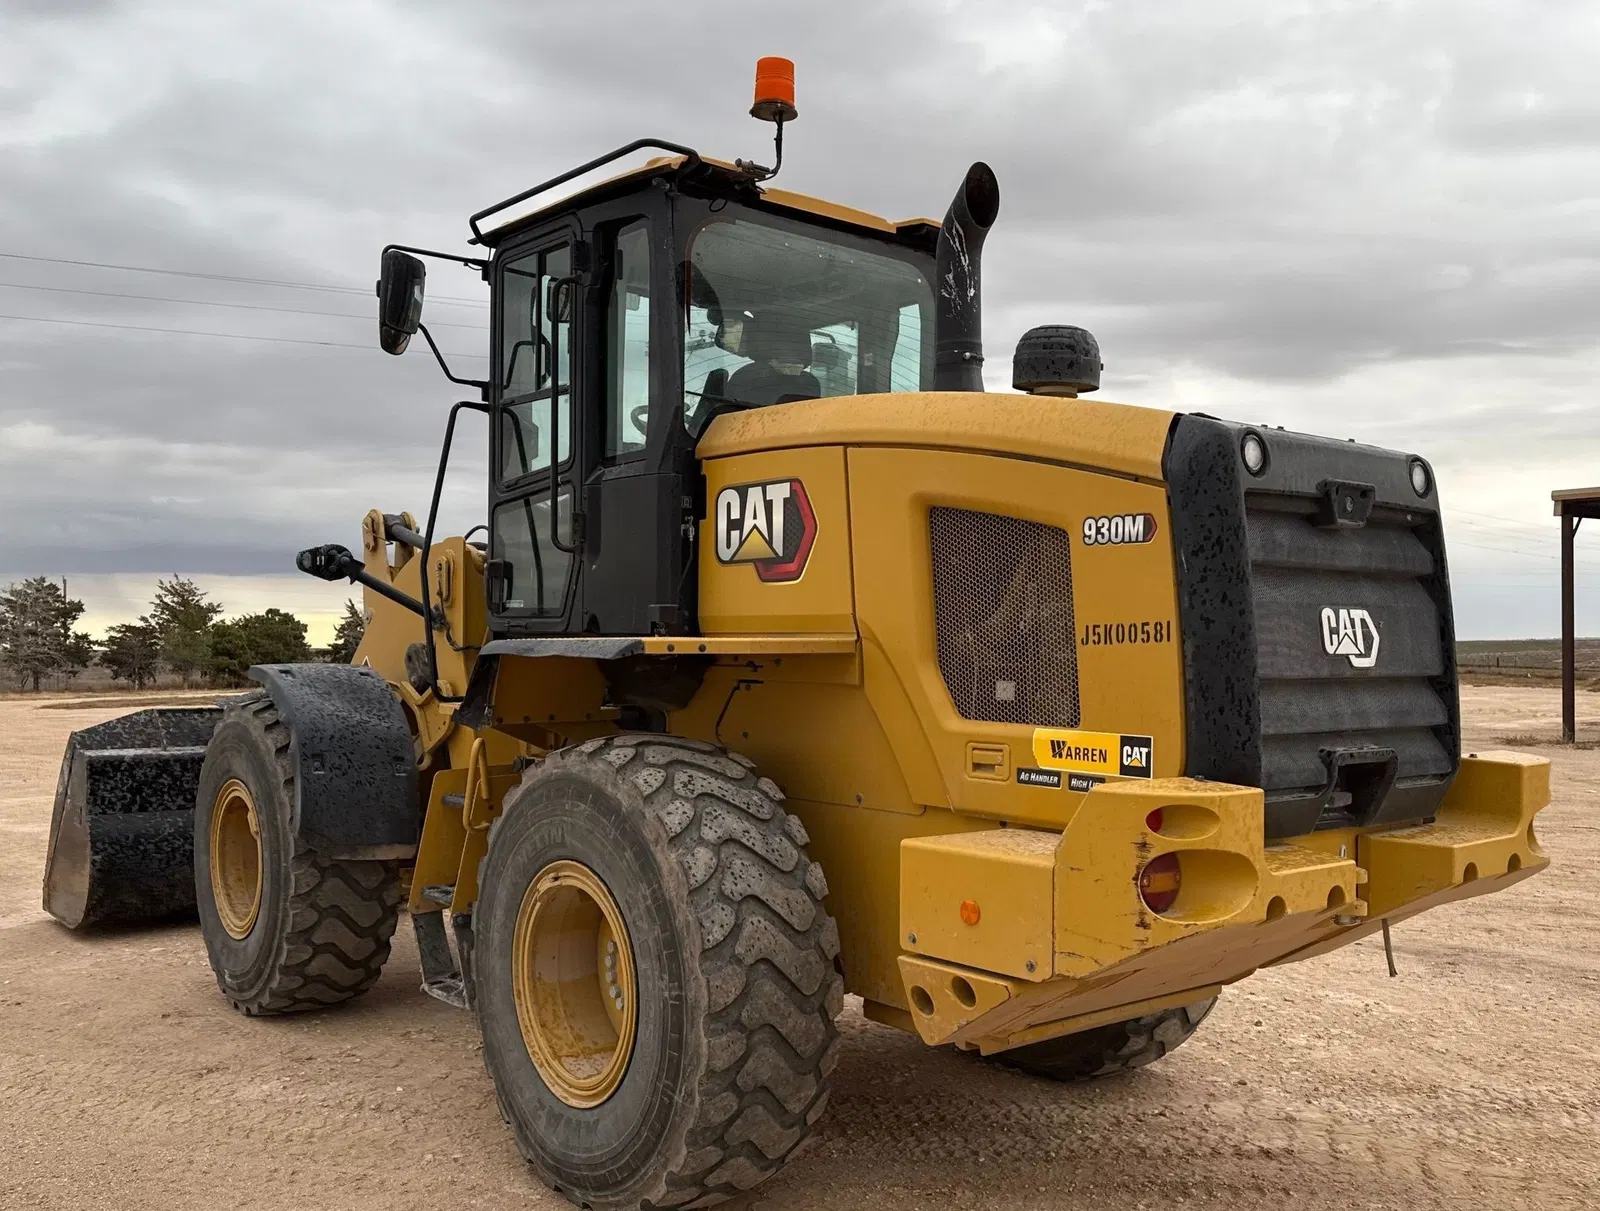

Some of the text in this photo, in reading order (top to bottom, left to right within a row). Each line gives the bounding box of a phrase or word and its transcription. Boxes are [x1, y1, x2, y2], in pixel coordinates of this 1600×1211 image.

[717, 481, 791, 561] CAT
[1083, 515, 1145, 544] 930M
[1081, 620, 1171, 646] J5K00581
[1321, 607, 1365, 655] CAT
[1050, 739, 1107, 763] WARREN
[1122, 745, 1148, 767] CAT
